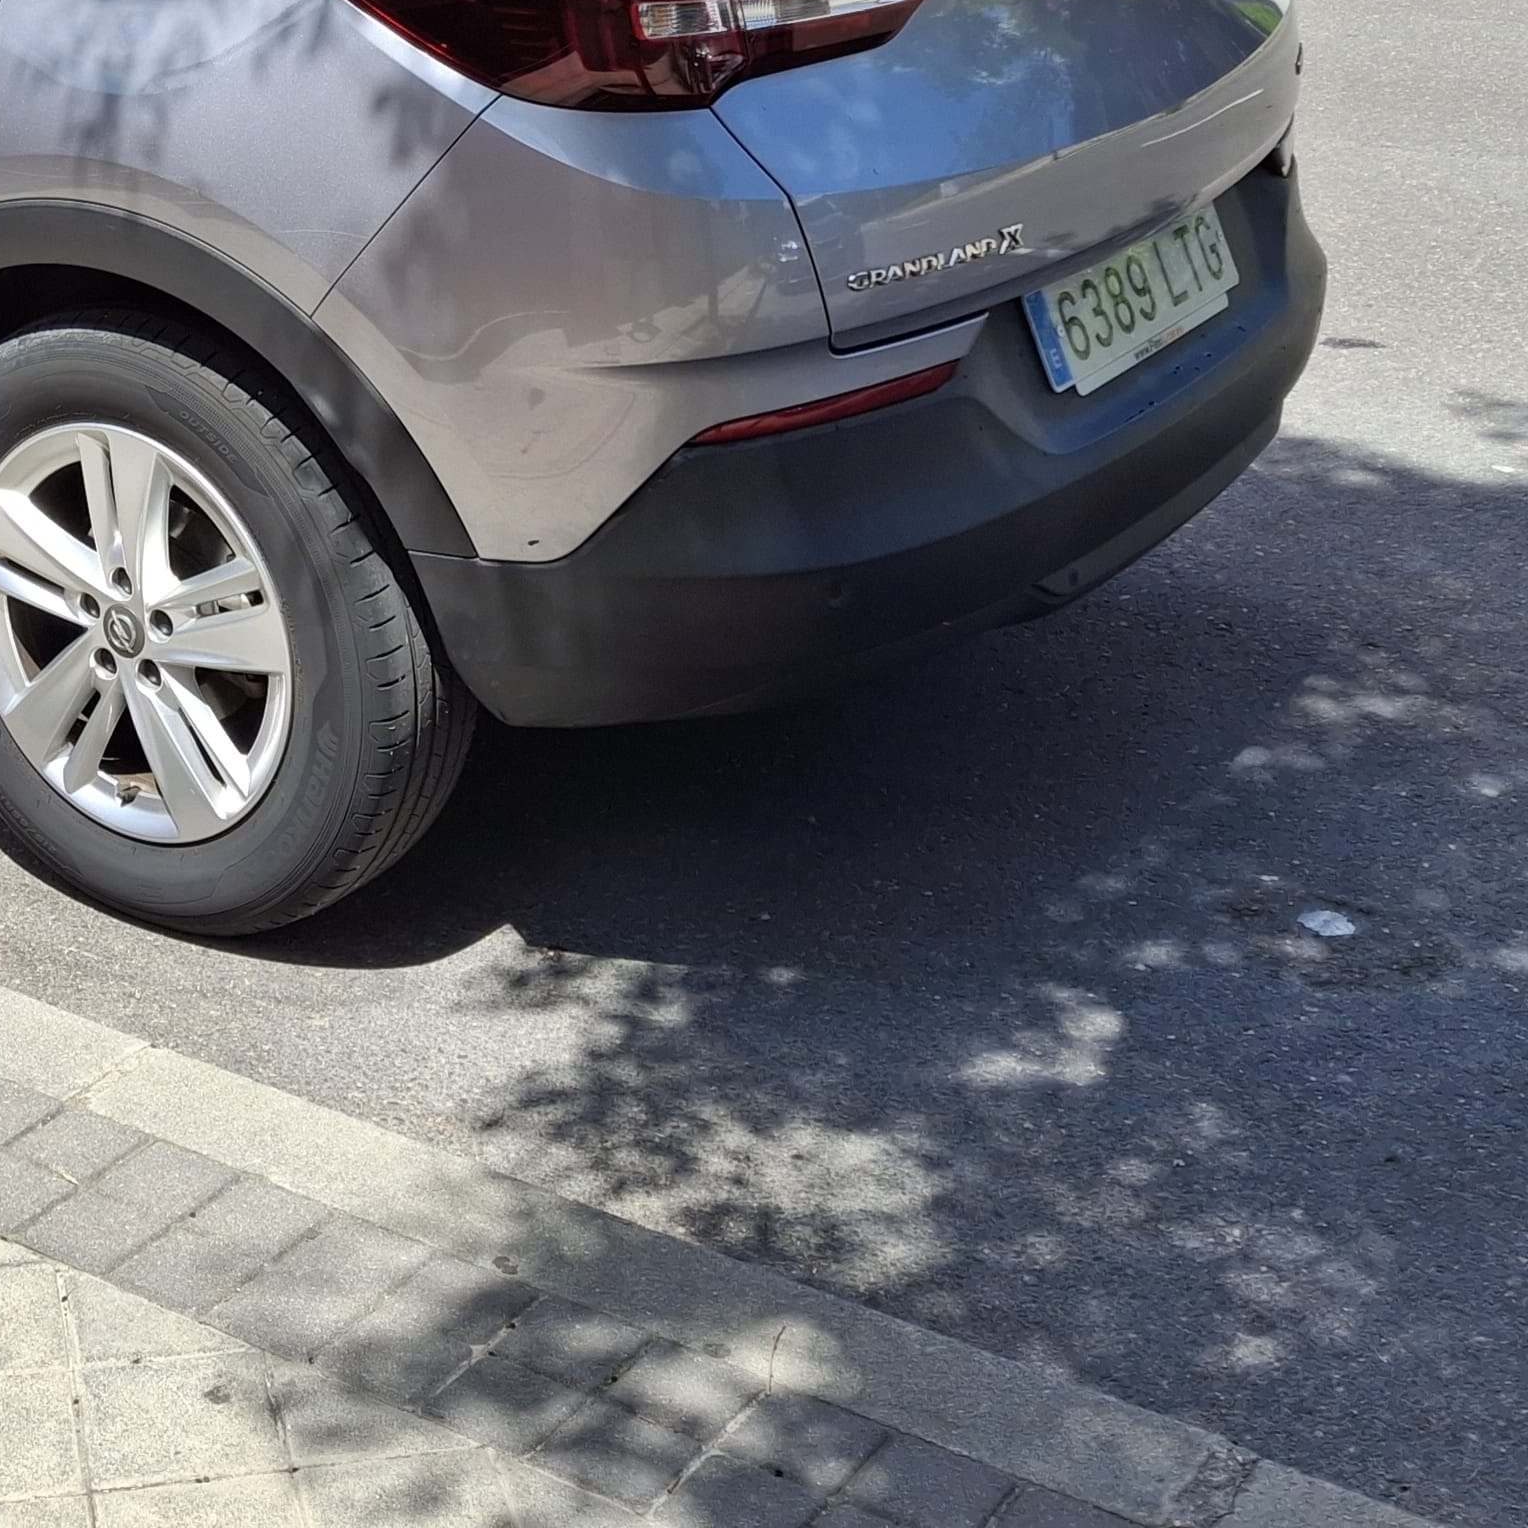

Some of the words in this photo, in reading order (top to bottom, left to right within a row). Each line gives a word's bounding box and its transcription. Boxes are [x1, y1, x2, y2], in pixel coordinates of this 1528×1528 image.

[847, 237, 998, 290] GRANDLAND
[1057, 254, 1158, 362] 6389
[1152, 215, 1224, 308] LTG
[178, 410, 239, 464] OUTSIDE
